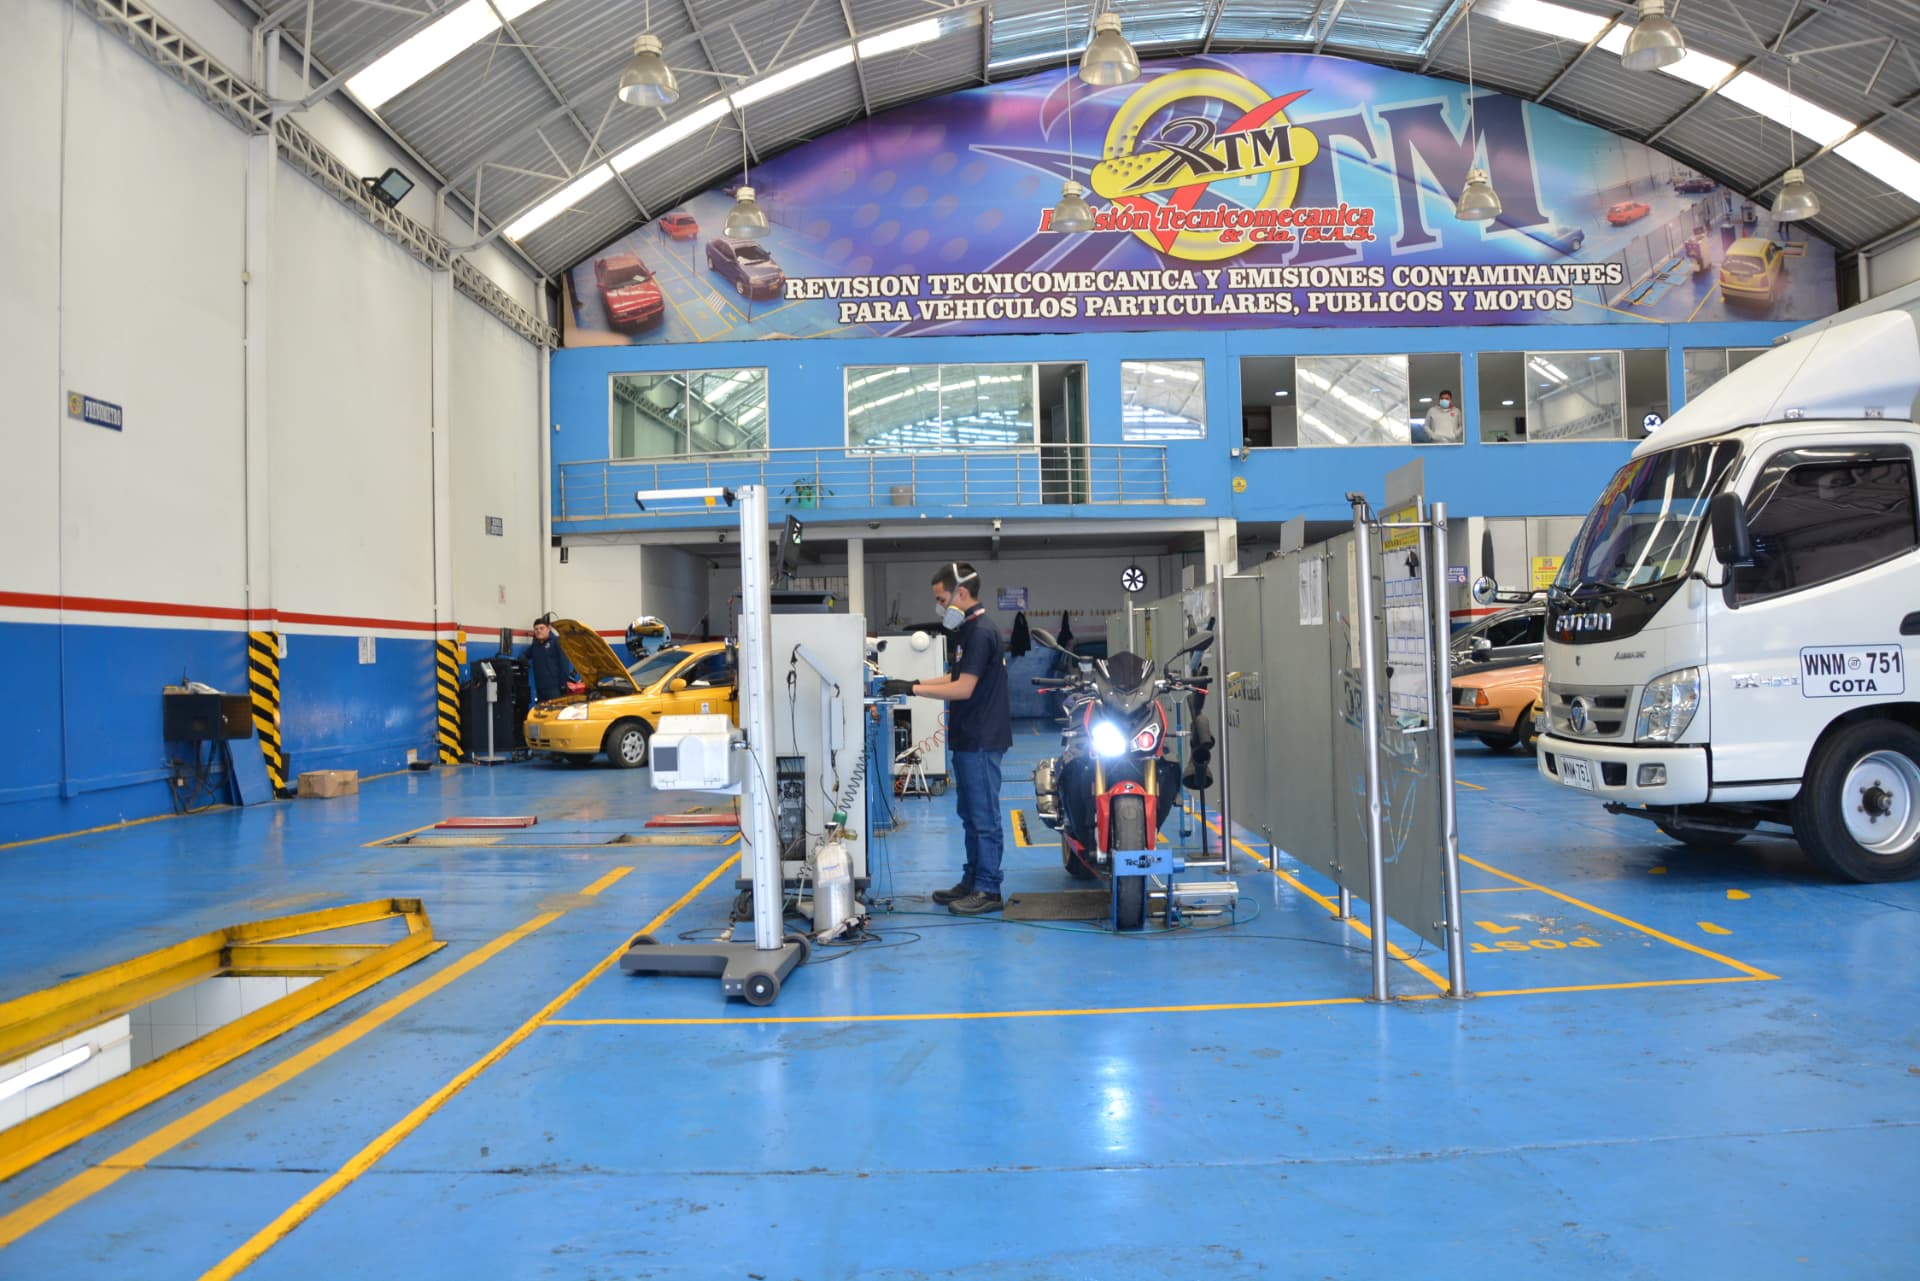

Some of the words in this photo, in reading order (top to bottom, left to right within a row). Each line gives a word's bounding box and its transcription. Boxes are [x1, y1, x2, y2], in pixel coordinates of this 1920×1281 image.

[1157, 203, 1375, 231] Tecnicomecanica
[1218, 228, 1243, 243] &
[1249, 227, 1297, 243] Cia.
[1303, 226, 1376, 243] S.A.S.
[784, 275, 920, 300] REVISION
[928, 268, 1199, 297] TECNICOMECANICA
[1203, 267, 1223, 290] Y
[1227, 266, 1385, 290] EMISIONES
[1391, 262, 1624, 288] CONTAMINANTES
[838, 299, 912, 324] PARA
[920, 295, 1078, 322] VEHICULOS
[1084, 292, 1300, 318] PARTICULARES,
[1307, 289, 1443, 314] PUBLICOS
[1444, 289, 1465, 313] Y
[1473, 288, 1573, 312] MOTOS
[1803, 653, 1846, 676] WNM
[1866, 651, 1901, 674] 751
[1828, 678, 1878, 693] COTA
